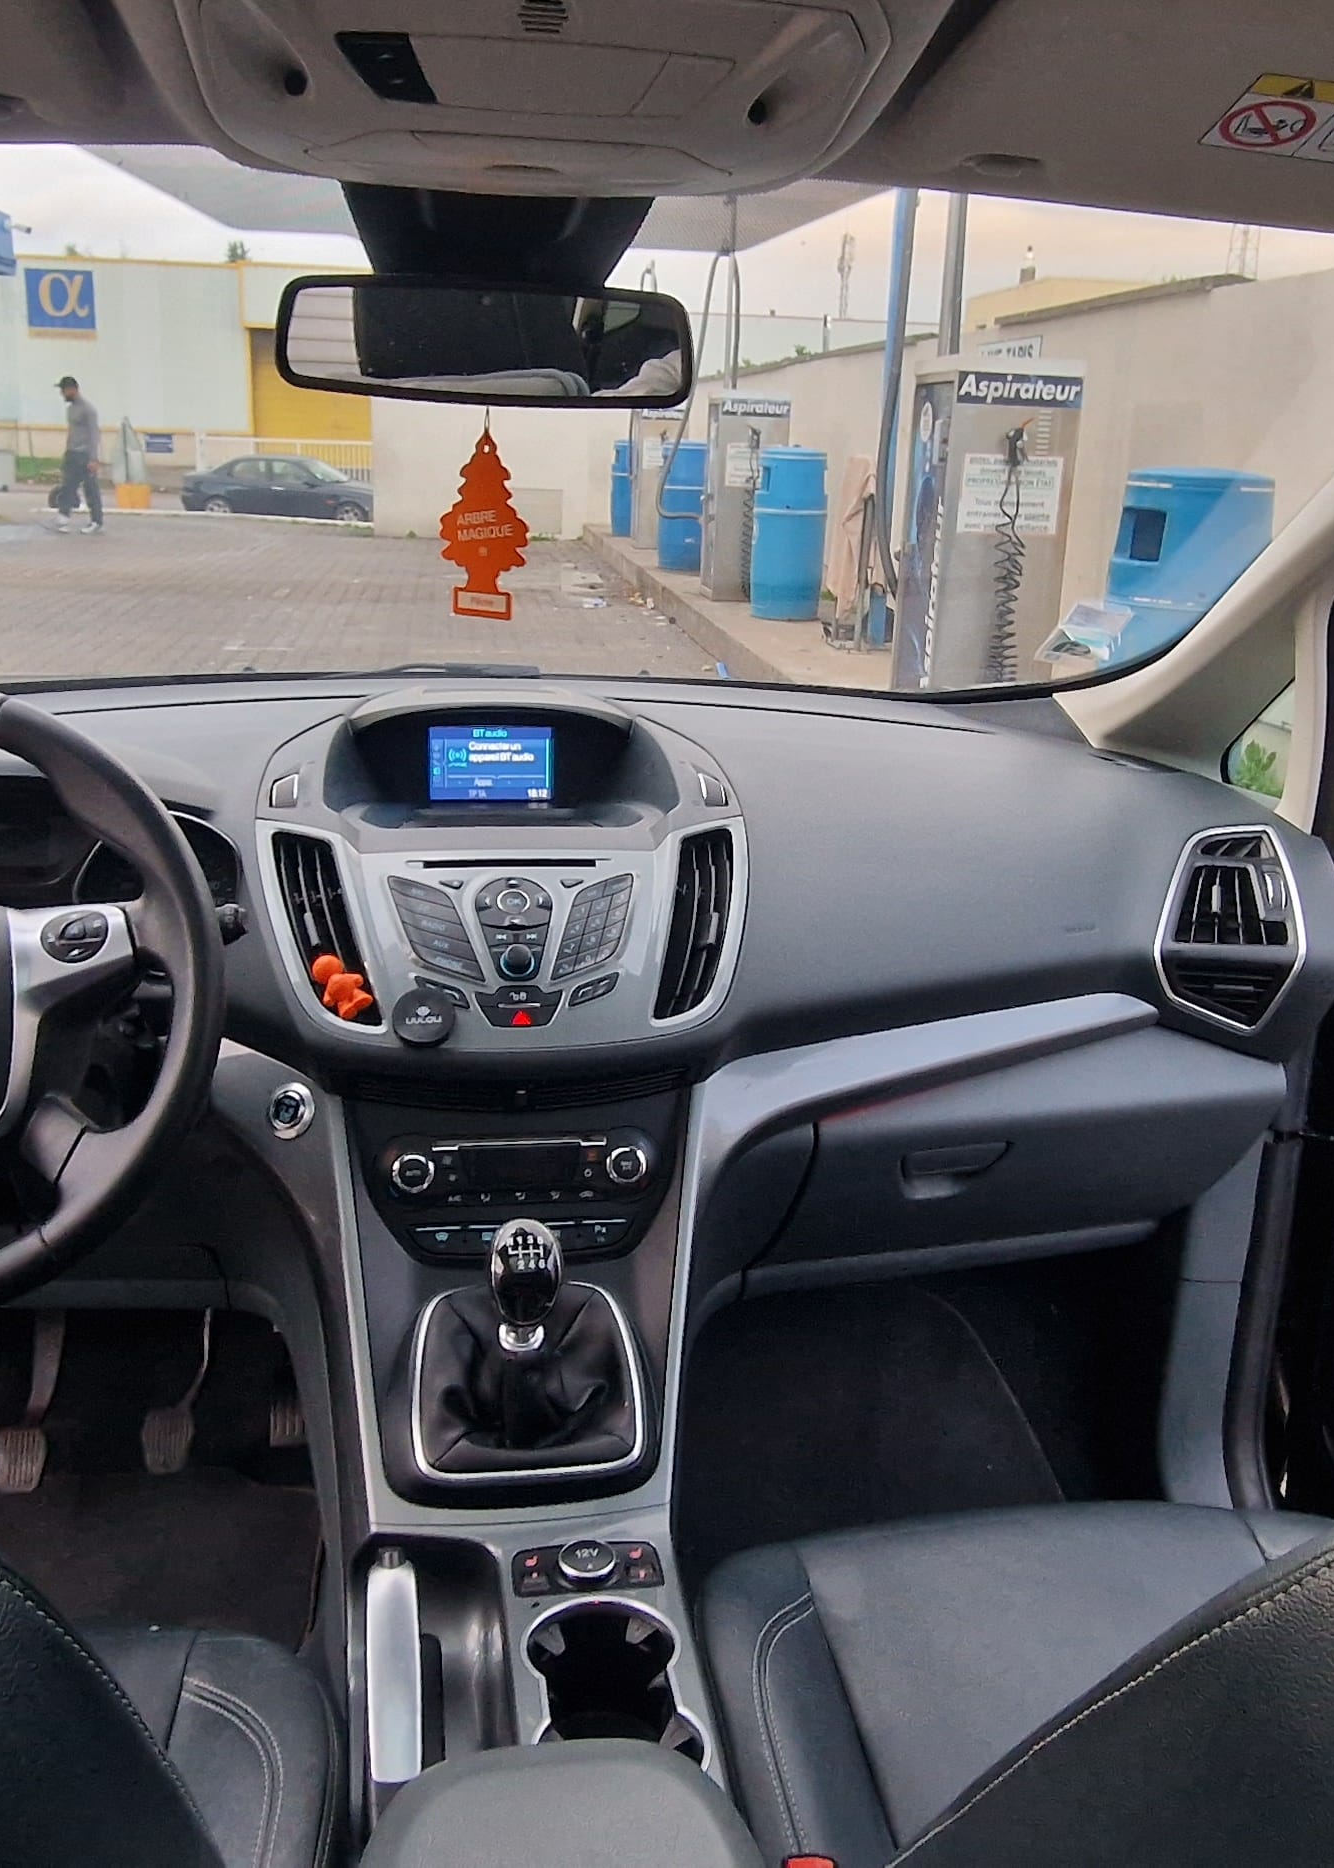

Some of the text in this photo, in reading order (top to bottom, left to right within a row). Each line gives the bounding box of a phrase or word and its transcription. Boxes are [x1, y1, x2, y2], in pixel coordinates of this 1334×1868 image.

[958, 373, 1081, 404] Aspirateur
[722, 401, 790, 415] Aspirateur
[457, 510, 497, 526] ARBRE
[458, 523, 514, 541] MAGIQUE
[485, 729, 508, 738] audio
[512, 753, 535, 762] audio
[574, 1547, 599, 1559] 12V
